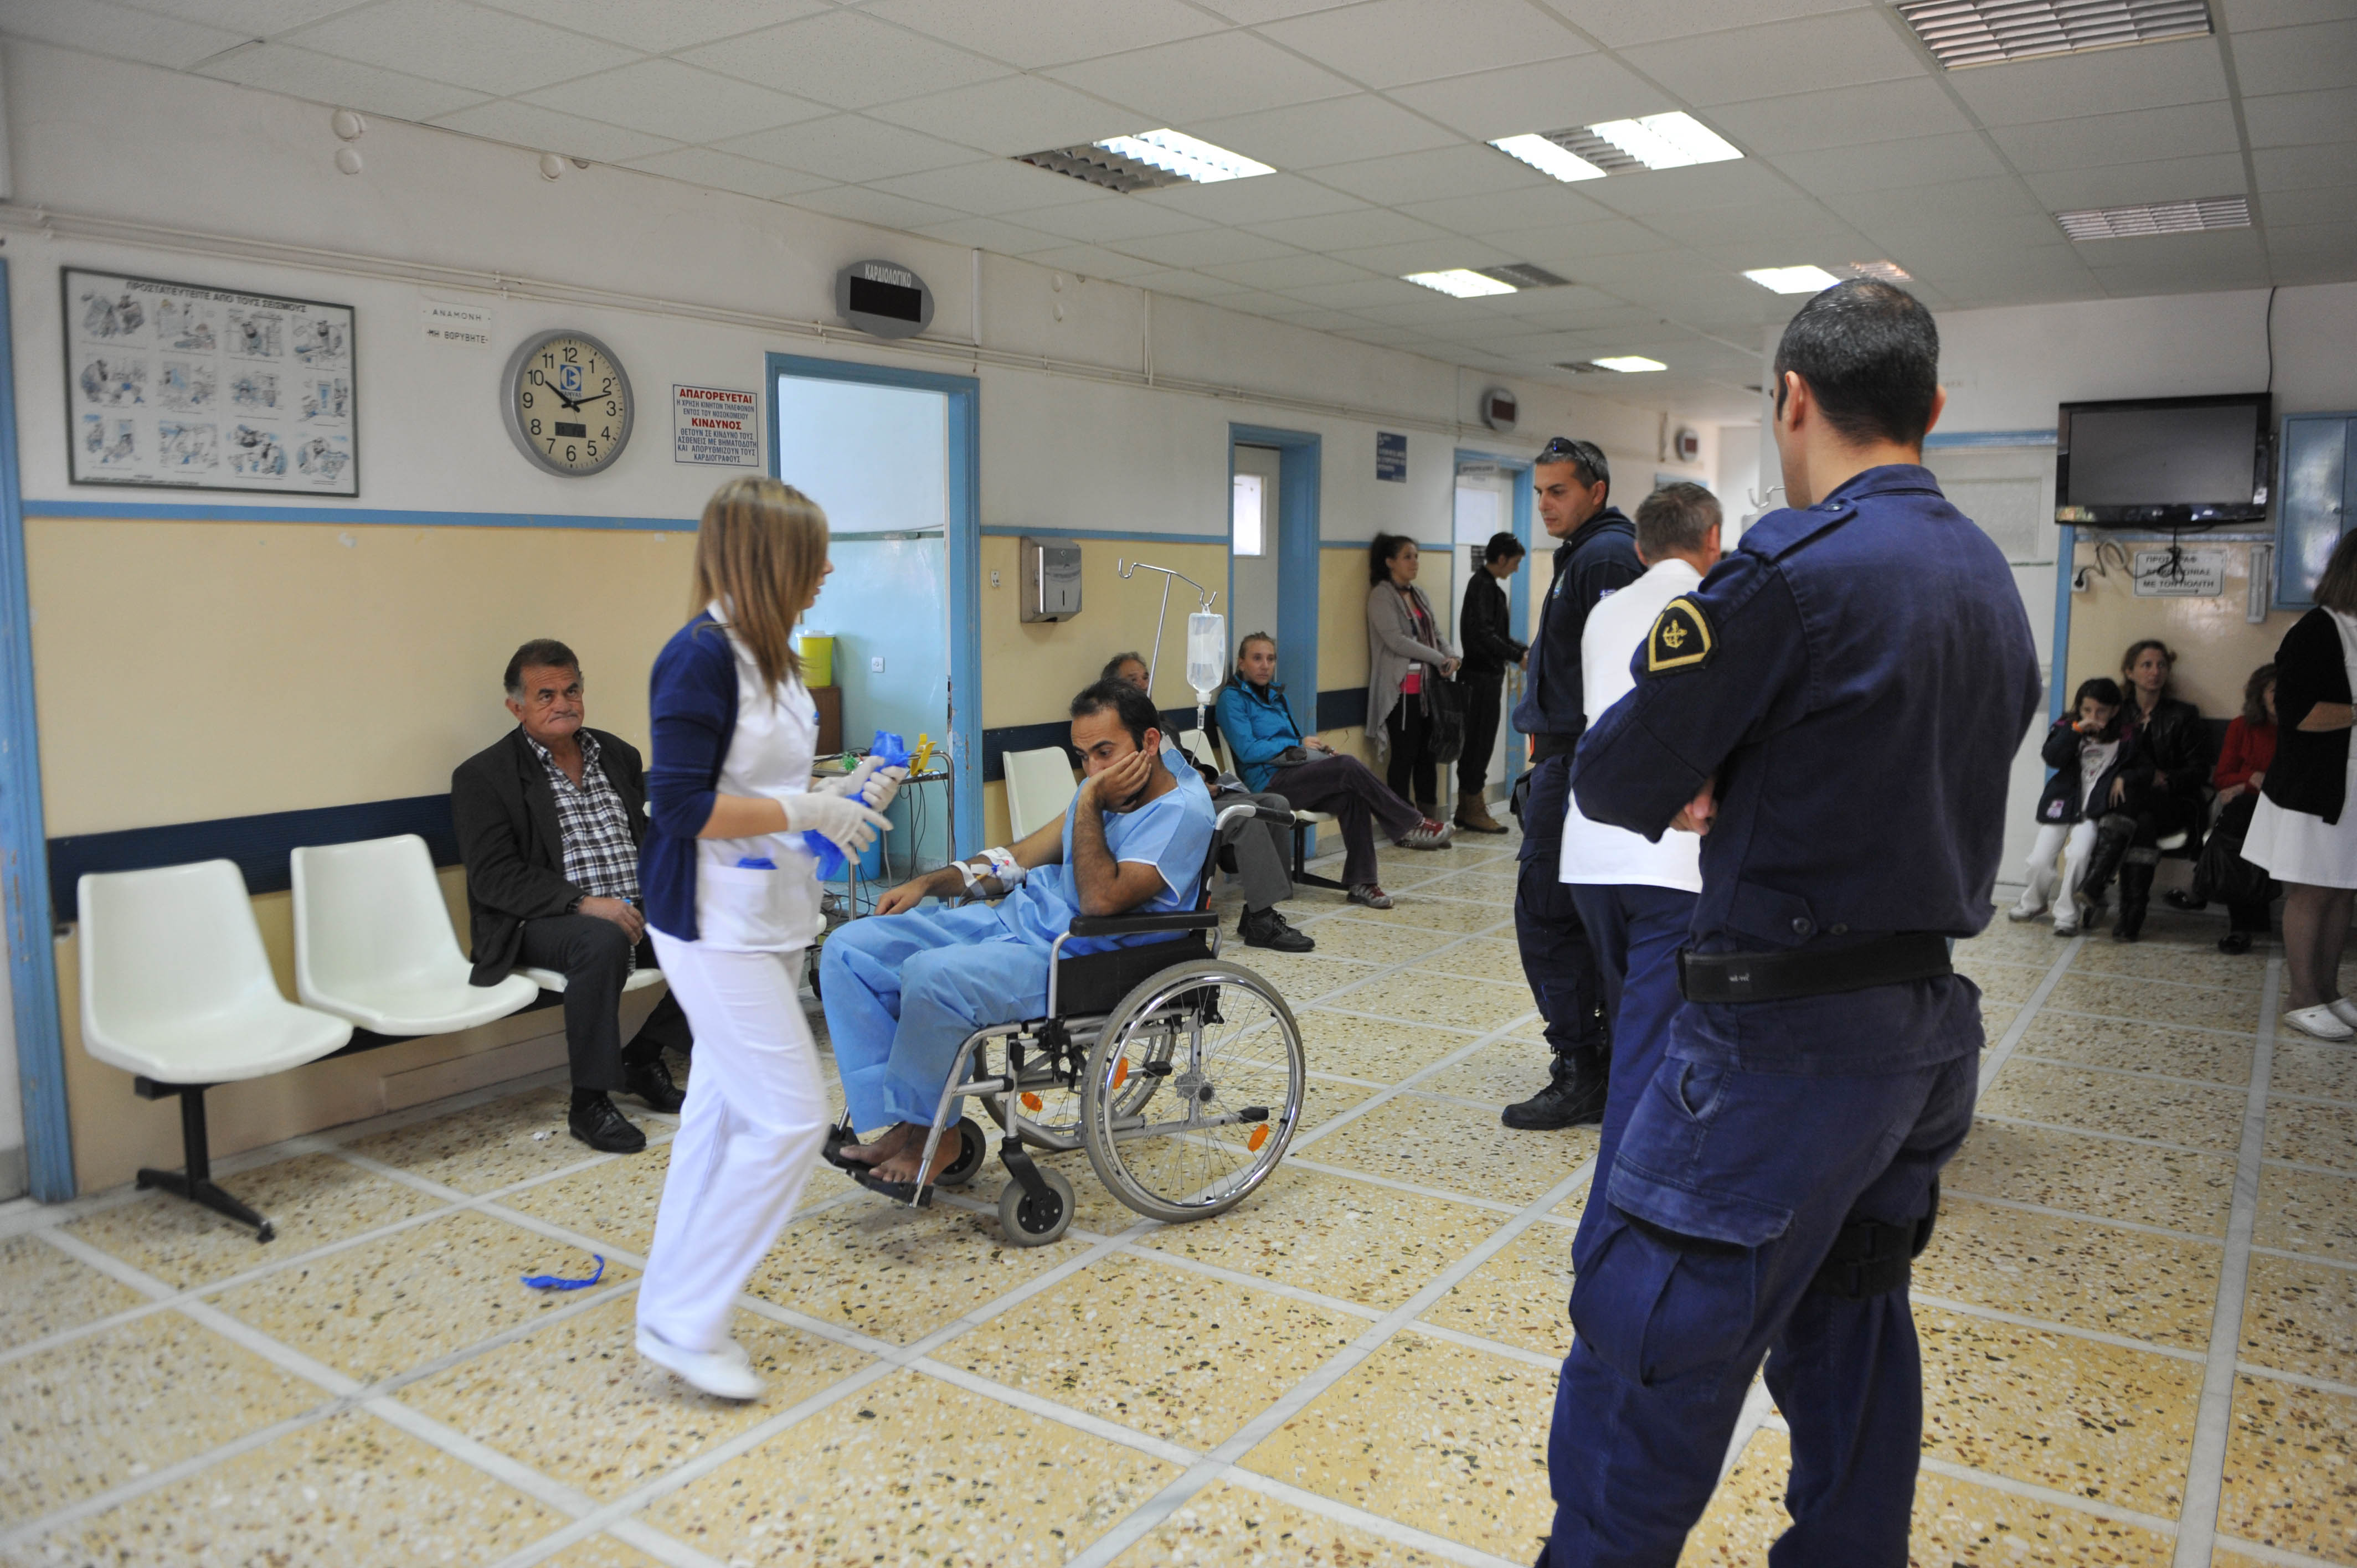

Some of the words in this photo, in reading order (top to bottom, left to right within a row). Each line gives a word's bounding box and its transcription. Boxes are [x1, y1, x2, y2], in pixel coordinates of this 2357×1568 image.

[865, 263, 911, 288] ΚΑΡΔΙΟΛΟΓΙΚΟ
[542, 353, 554, 369] 11
[563, 347, 578, 363] 12
[589, 359, 594, 374] 1
[527, 369, 544, 386] 10
[603, 378, 612, 395] 2
[523, 392, 533, 409] 9
[680, 389, 752, 404] ΑΠΑΓΟΡΕΥΕΤΑΙ
[606, 401, 616, 416] 3
[713, 411, 748, 420] ΝΟΣΟΚΟΜΕΙΟΥ
[724, 404, 754, 412] ΤΗΛΕΦΩΝΩΝ
[531, 419, 541, 435] 8
[692, 417, 742, 430] ΚΙΝΔΥΝΟΣ
[601, 426, 610, 441] 4
[681, 428, 703, 436] ΘΕΤΟΥΝ
[713, 431, 738, 439] ΚΙΝΔΥΝΟ
[547, 438, 555, 454] 7
[587, 440, 597, 456] 5
[678, 436, 706, 445] ΑΣΘΕΝΕΙΣ
[718, 439, 756, 449] ΒΗΜΑΤΟΔΟΤΗ
[566, 445, 576, 461] 6
[692, 445, 739, 455] ΑΠΟΡΥΘΜΙΖΟΥΝ
[740, 448, 755, 456] ΤΟΥΣ
[694, 453, 740, 463] ΚΑΡΔΙΟΓΡΑΦΟΥΣ
